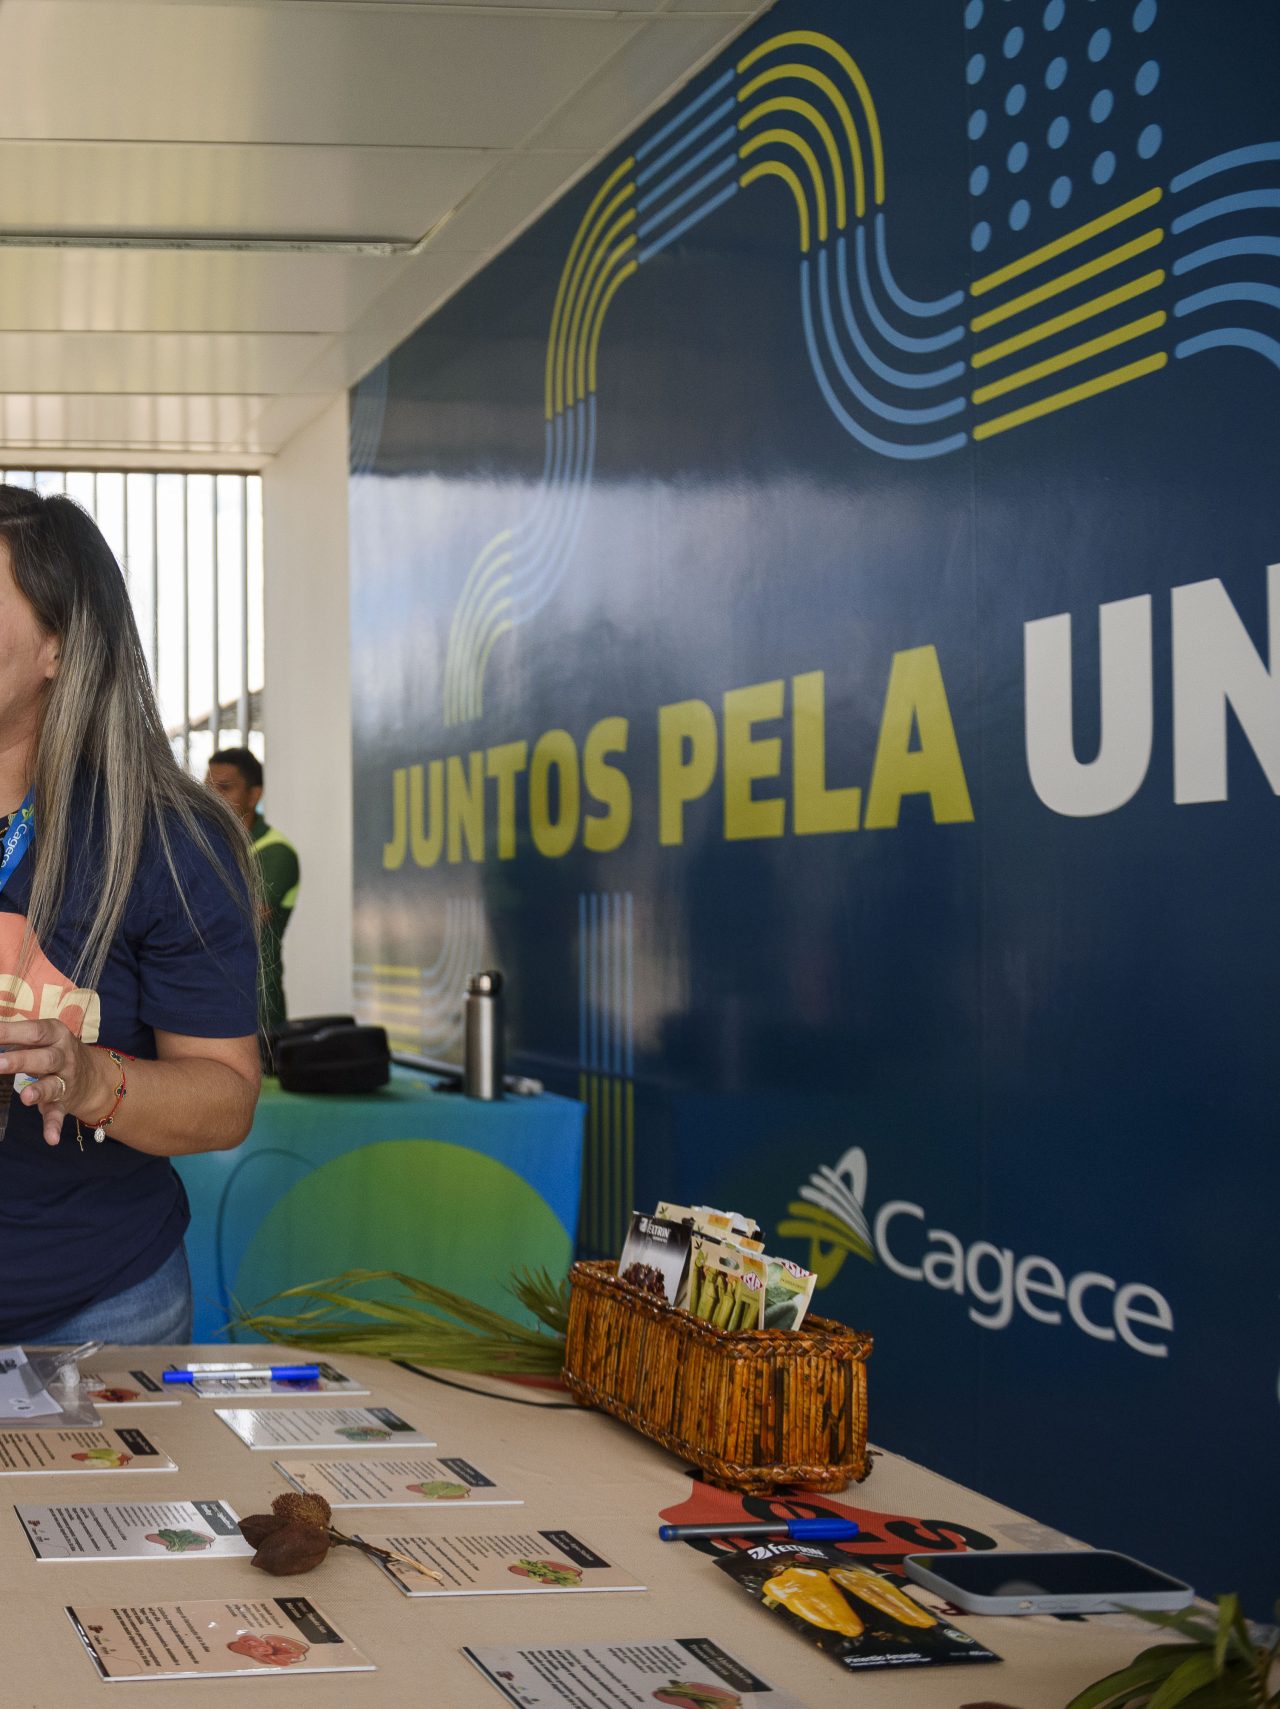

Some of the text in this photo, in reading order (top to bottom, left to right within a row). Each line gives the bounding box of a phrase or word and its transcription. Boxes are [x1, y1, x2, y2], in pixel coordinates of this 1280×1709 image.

[382, 716, 632, 870] JUNTOS
[657, 645, 975, 846] PELA
[874, 1200, 1174, 1358] Cagece
